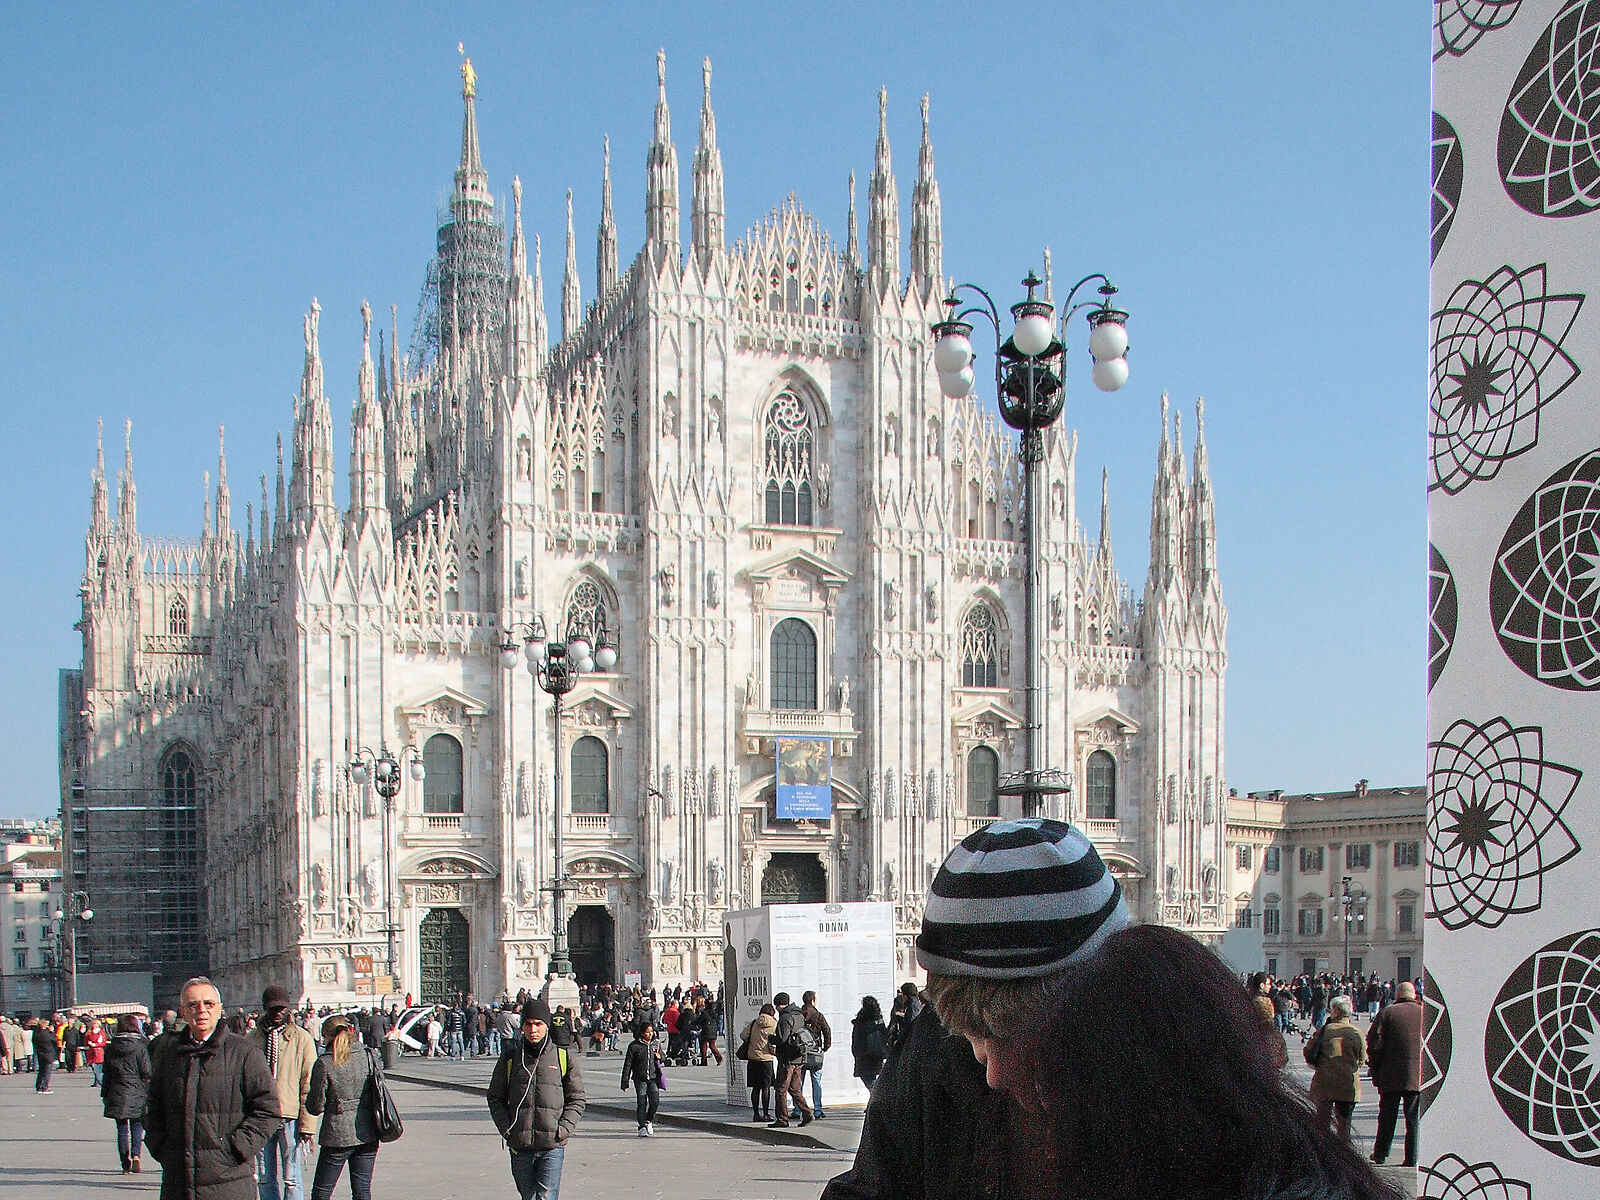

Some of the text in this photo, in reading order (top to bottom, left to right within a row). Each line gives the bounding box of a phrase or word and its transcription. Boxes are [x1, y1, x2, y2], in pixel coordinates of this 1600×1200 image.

[819, 922, 849, 932] DONNA
[357, 959, 371, 970] M
[743, 976, 768, 996] DONNA
